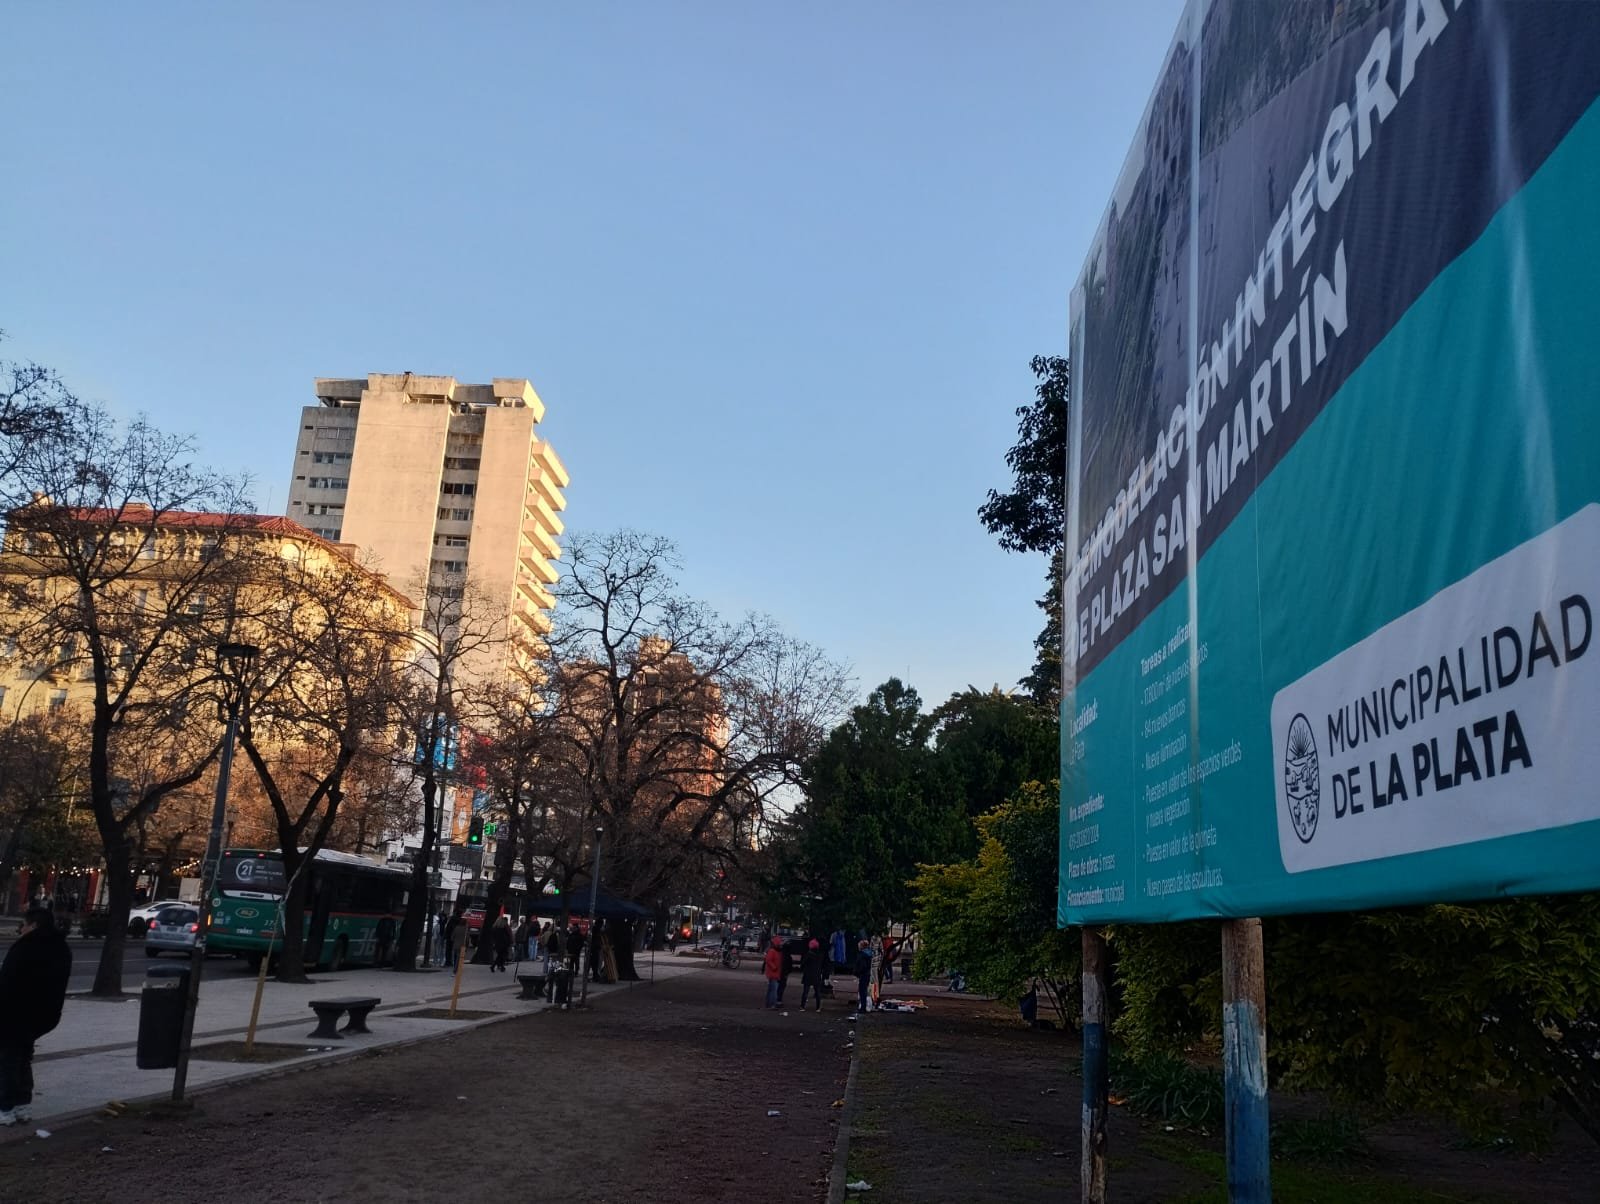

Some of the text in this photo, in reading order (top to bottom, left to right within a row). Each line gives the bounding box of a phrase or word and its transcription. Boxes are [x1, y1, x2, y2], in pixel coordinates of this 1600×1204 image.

[1236, 0, 1463, 367] INTEGRA
[1090, 537, 1149, 646] PLAZA
[1151, 463, 1201, 576] SAN
[1206, 238, 1348, 515] MARTÍN
[1140, 648, 1162, 677] Tareas
[1162, 645, 1167, 661] a
[1327, 593, 1593, 757] MUNICIPALIDAD
[1151, 711, 1168, 735] nuevos
[1167, 698, 1186, 724] bancos
[1187, 762, 1196, 784] los
[1196, 750, 1221, 784] espacios
[1220, 738, 1242, 768] verdes
[1332, 710, 1532, 819] DE LA PLATA
[1181, 831, 1189, 853] de
[240, 864, 253, 876] 21
[1146, 877, 1162, 897] Nuevo
[1161, 875, 1176, 900] paseo
[1192, 865, 1223, 890] esculturas
